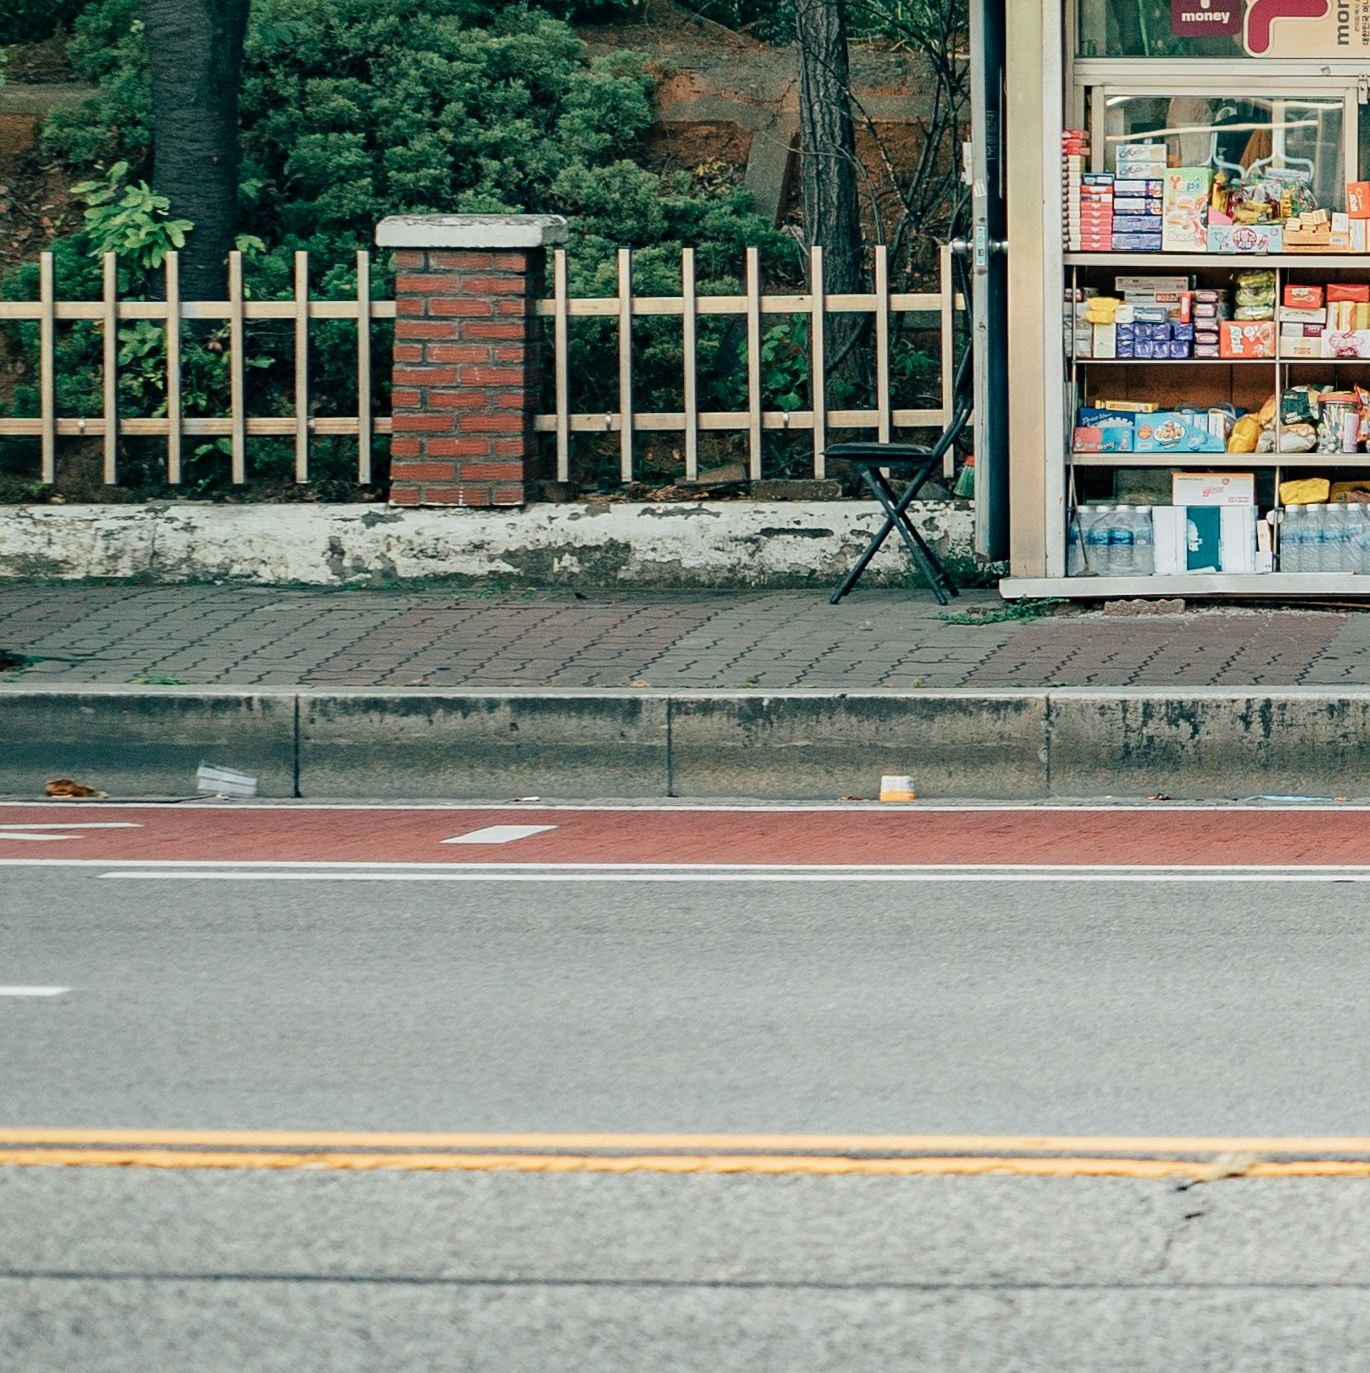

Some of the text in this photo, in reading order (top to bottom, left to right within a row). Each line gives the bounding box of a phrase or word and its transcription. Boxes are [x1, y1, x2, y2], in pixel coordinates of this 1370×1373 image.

[1181, 10, 1230, 25] money
[1361, 15, 1370, 46] 대한민국
[1168, 175, 1202, 193] Yupi
